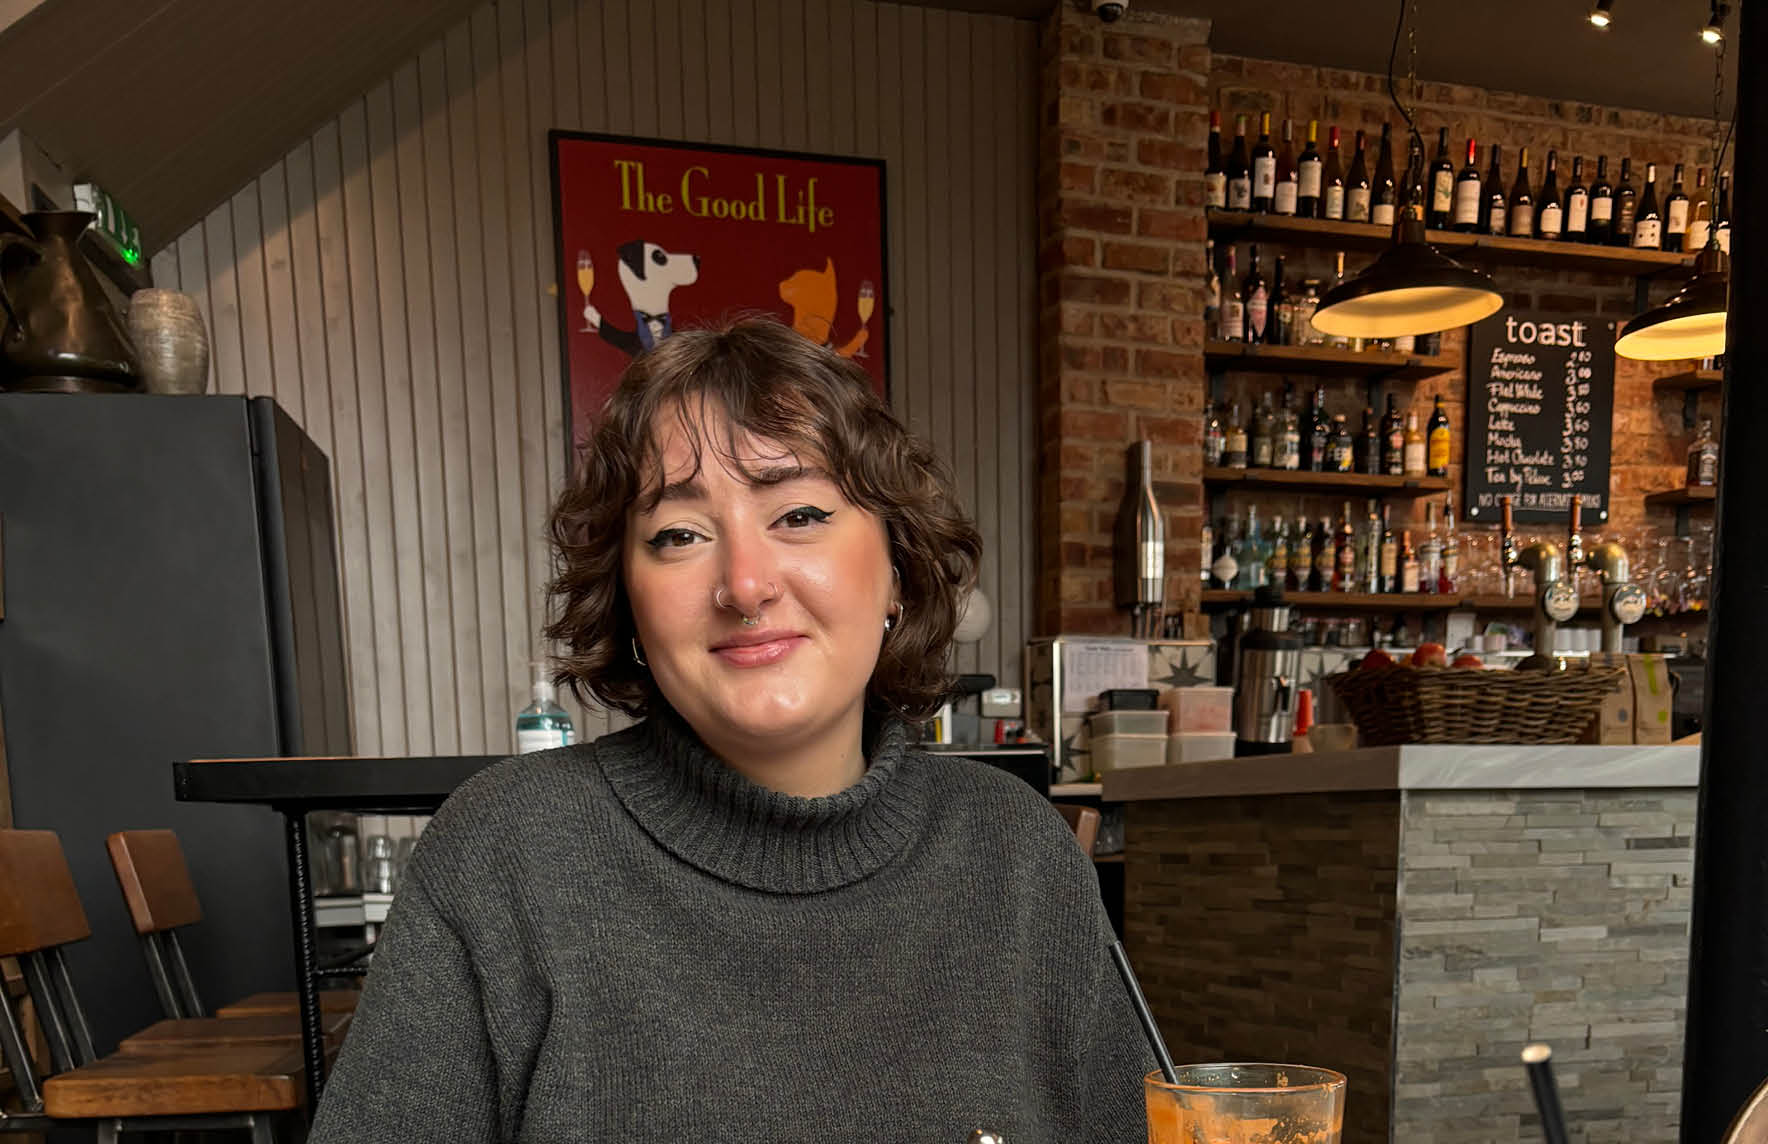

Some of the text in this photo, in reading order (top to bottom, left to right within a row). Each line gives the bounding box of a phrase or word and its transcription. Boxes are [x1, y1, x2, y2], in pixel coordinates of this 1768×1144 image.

[614, 159, 834, 232] The Good Life
[1505, 315, 1587, 347] toast
[1490, 365, 1543, 381] Americano
[1487, 449, 1510, 464] Hot
[1484, 467, 1506, 484] Tea
